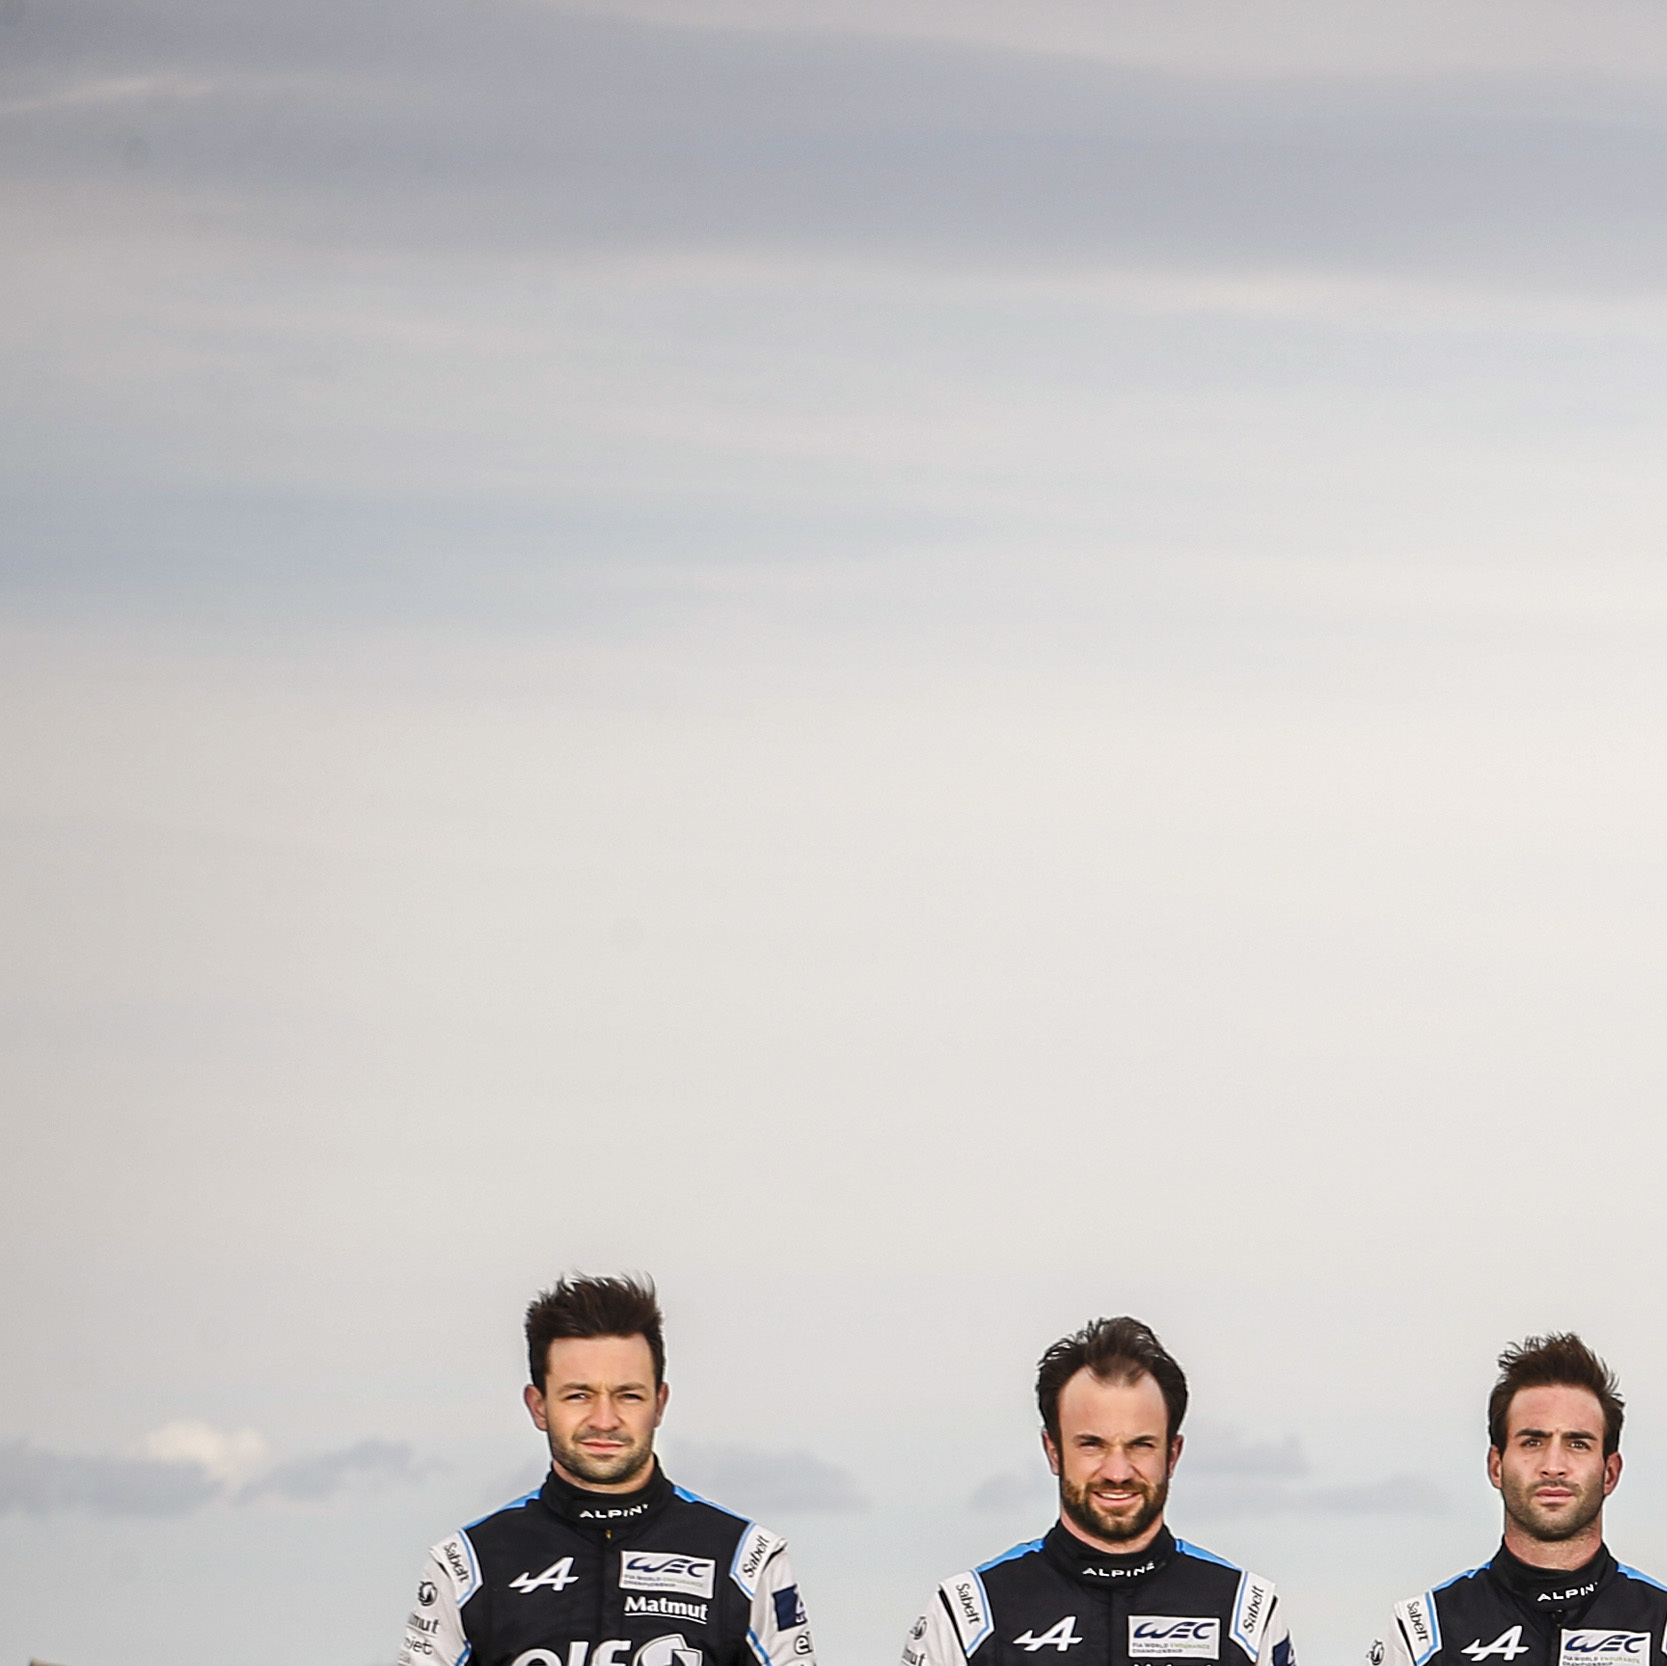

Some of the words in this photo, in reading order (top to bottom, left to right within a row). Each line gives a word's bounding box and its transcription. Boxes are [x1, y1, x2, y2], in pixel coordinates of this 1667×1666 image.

[579, 1503, 649, 1519] ALPIN
[626, 1556, 711, 1578] WEC
[1537, 1581, 1598, 1602] ALPIN
[624, 1596, 708, 1621] Matmut
[956, 1583, 982, 1625] Sabelt
[1242, 1585, 1265, 1634] Sabelt
[1133, 1621, 1216, 1640] WEC
[1406, 1601, 1429, 1642] Sabelt
[1565, 1635, 1647, 1654] WEC
